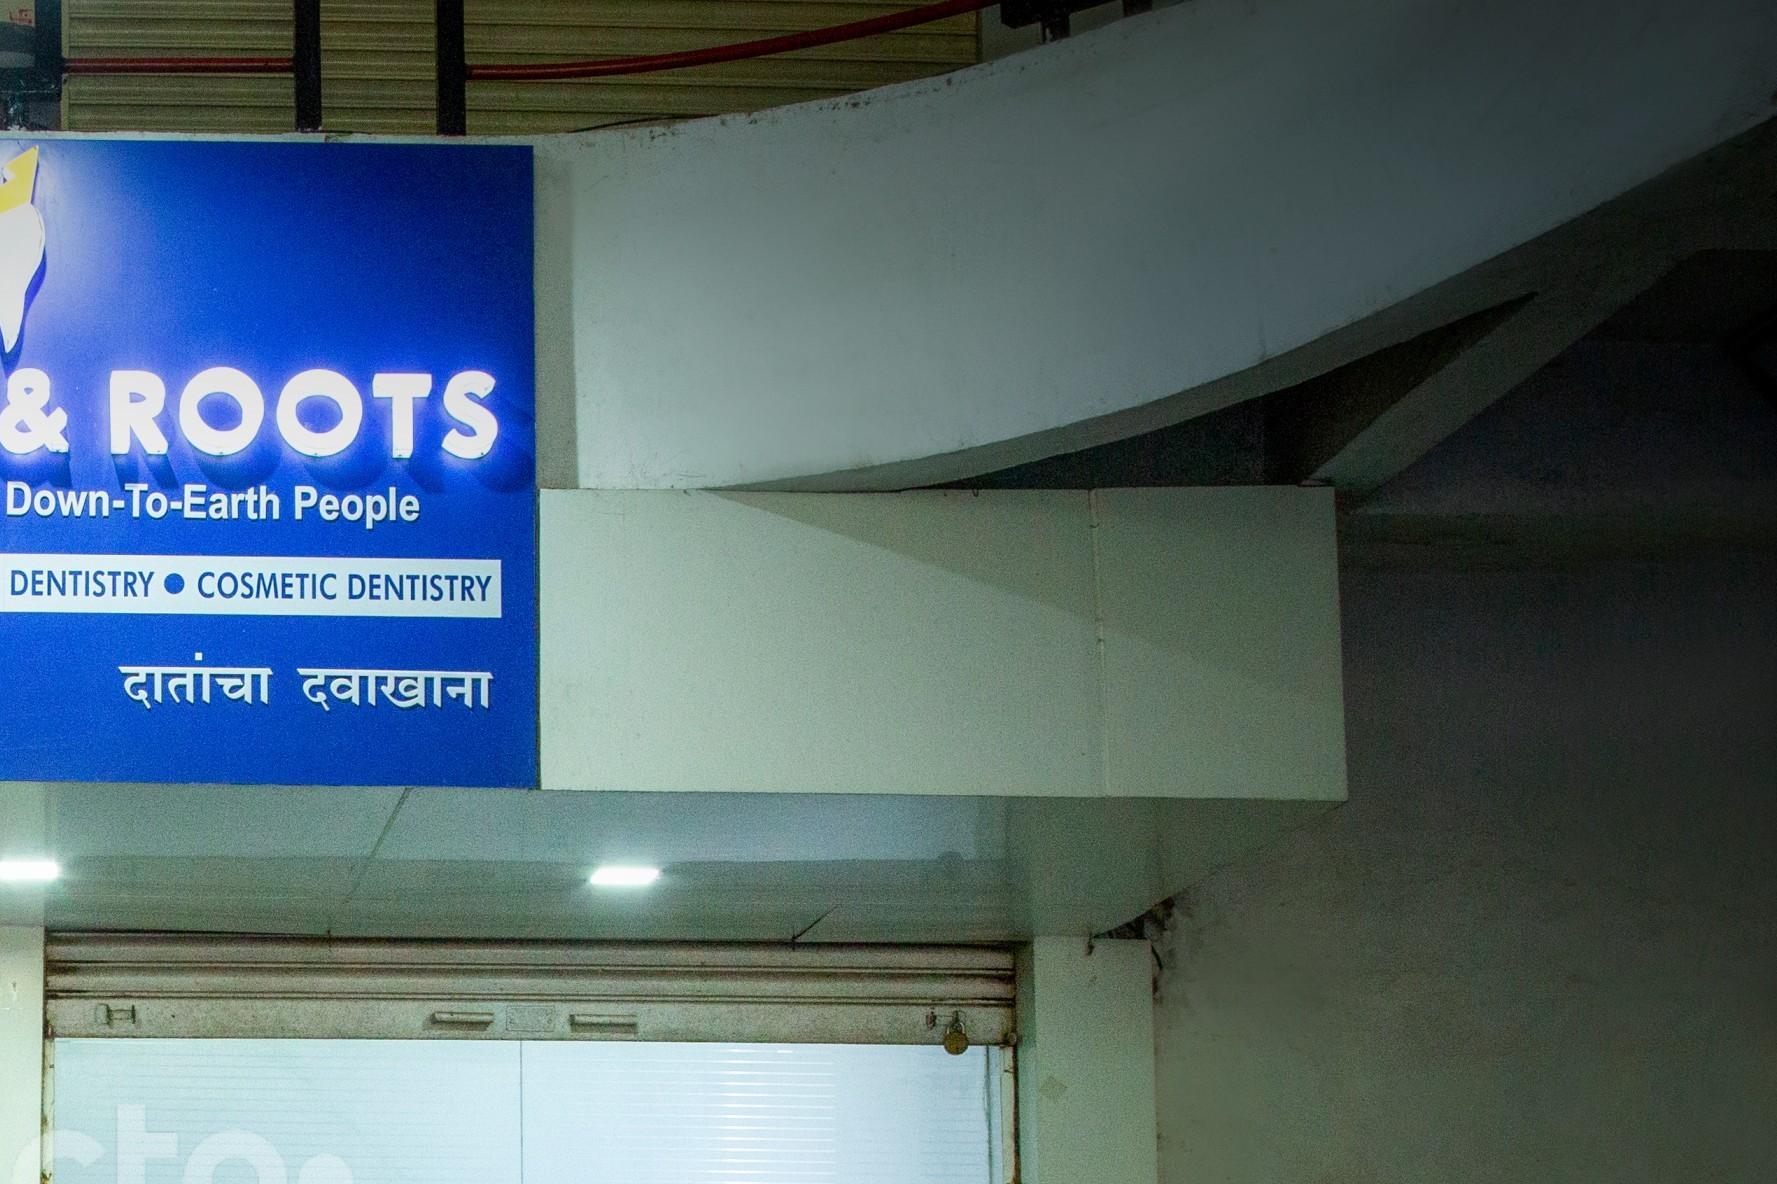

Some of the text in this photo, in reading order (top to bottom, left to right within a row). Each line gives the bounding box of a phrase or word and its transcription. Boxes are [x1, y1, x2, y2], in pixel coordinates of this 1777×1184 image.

[109, 366, 499, 460] ROOTS
[5, 481, 280, 521] Down-To-Earth
[294, 485, 420, 529] People
[10, 570, 155, 599] DENTISTRY
[197, 571, 340, 601] COSMETIC
[347, 574, 492, 602] DENTISTRY
[118, 652, 493, 711] दातांचा दवाखाना
